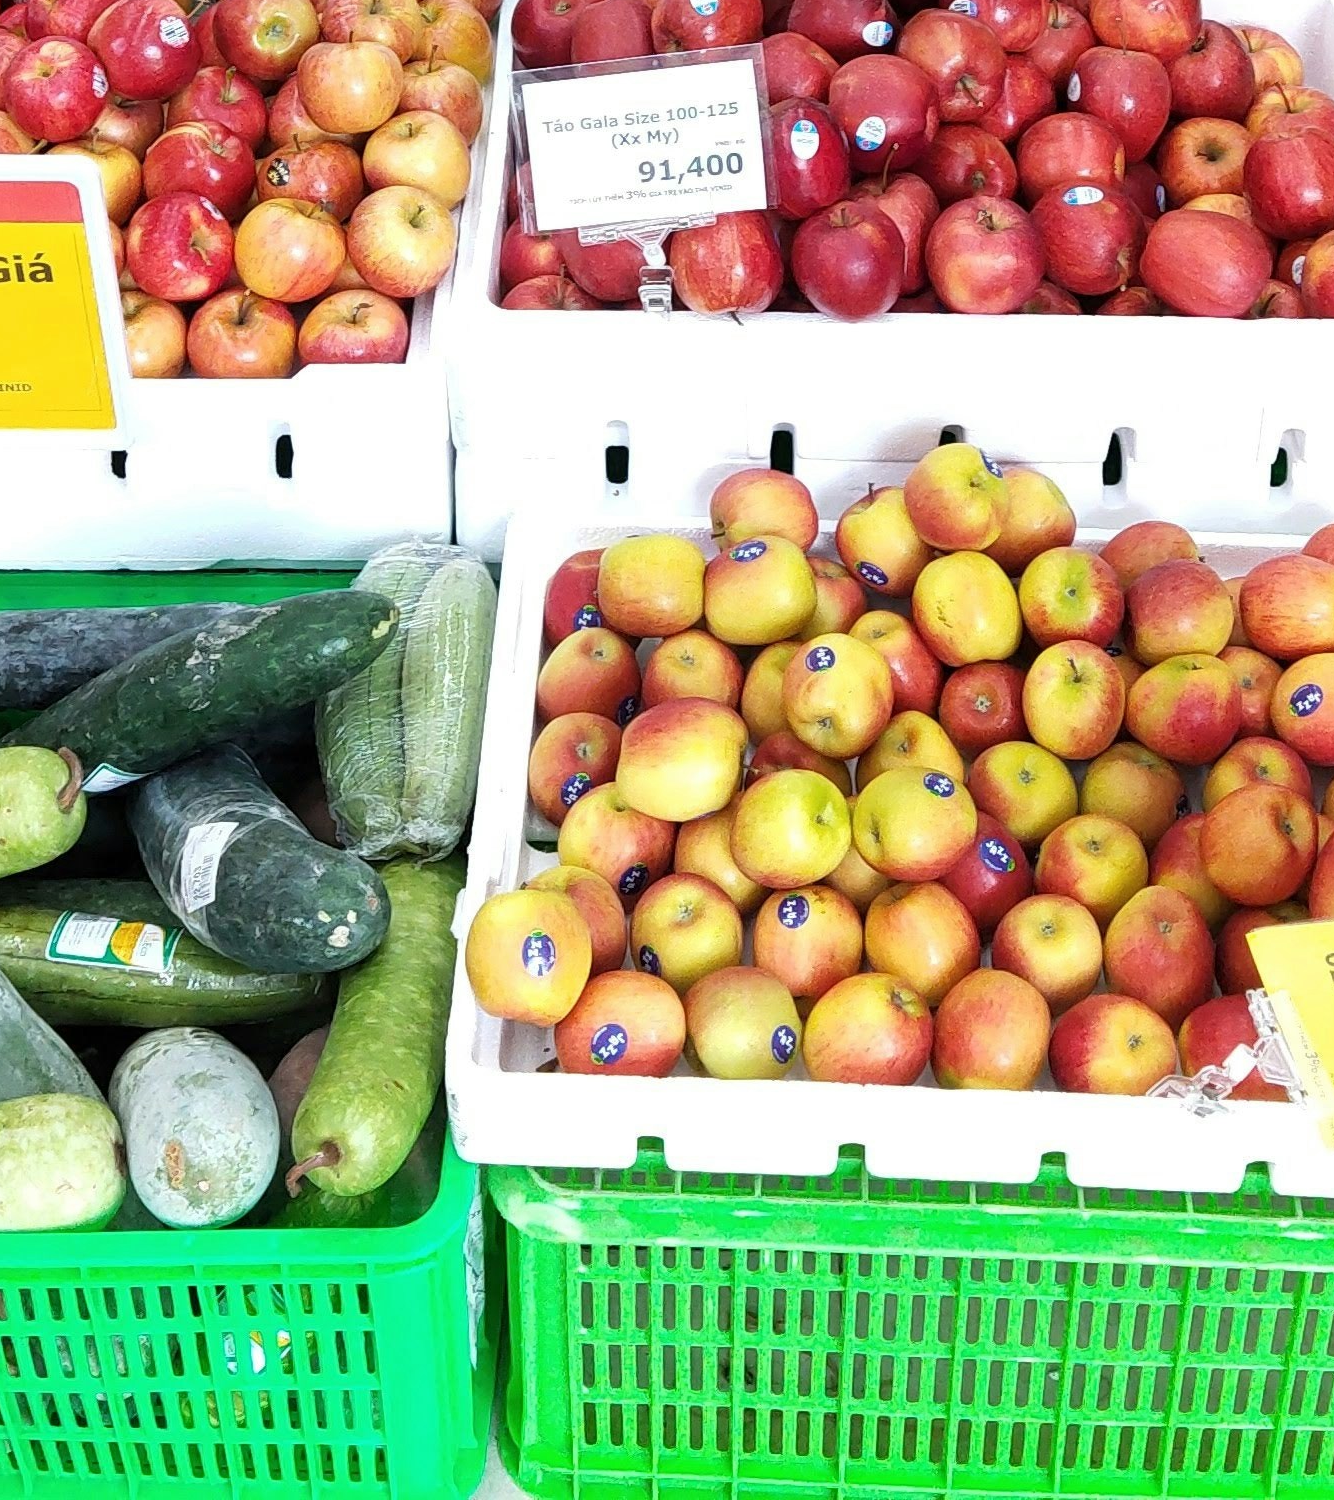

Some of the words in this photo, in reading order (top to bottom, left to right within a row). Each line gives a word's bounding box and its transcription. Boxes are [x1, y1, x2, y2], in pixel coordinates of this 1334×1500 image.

[542, 118, 574, 133] Táo
[580, 114, 619, 130] Gala
[624, 111, 660, 126] Size
[666, 101, 739, 121] 100-125
[611, 132, 641, 150] (Xx
[638, 152, 743, 185] 91,400
[626, 189, 647, 201] 3%
